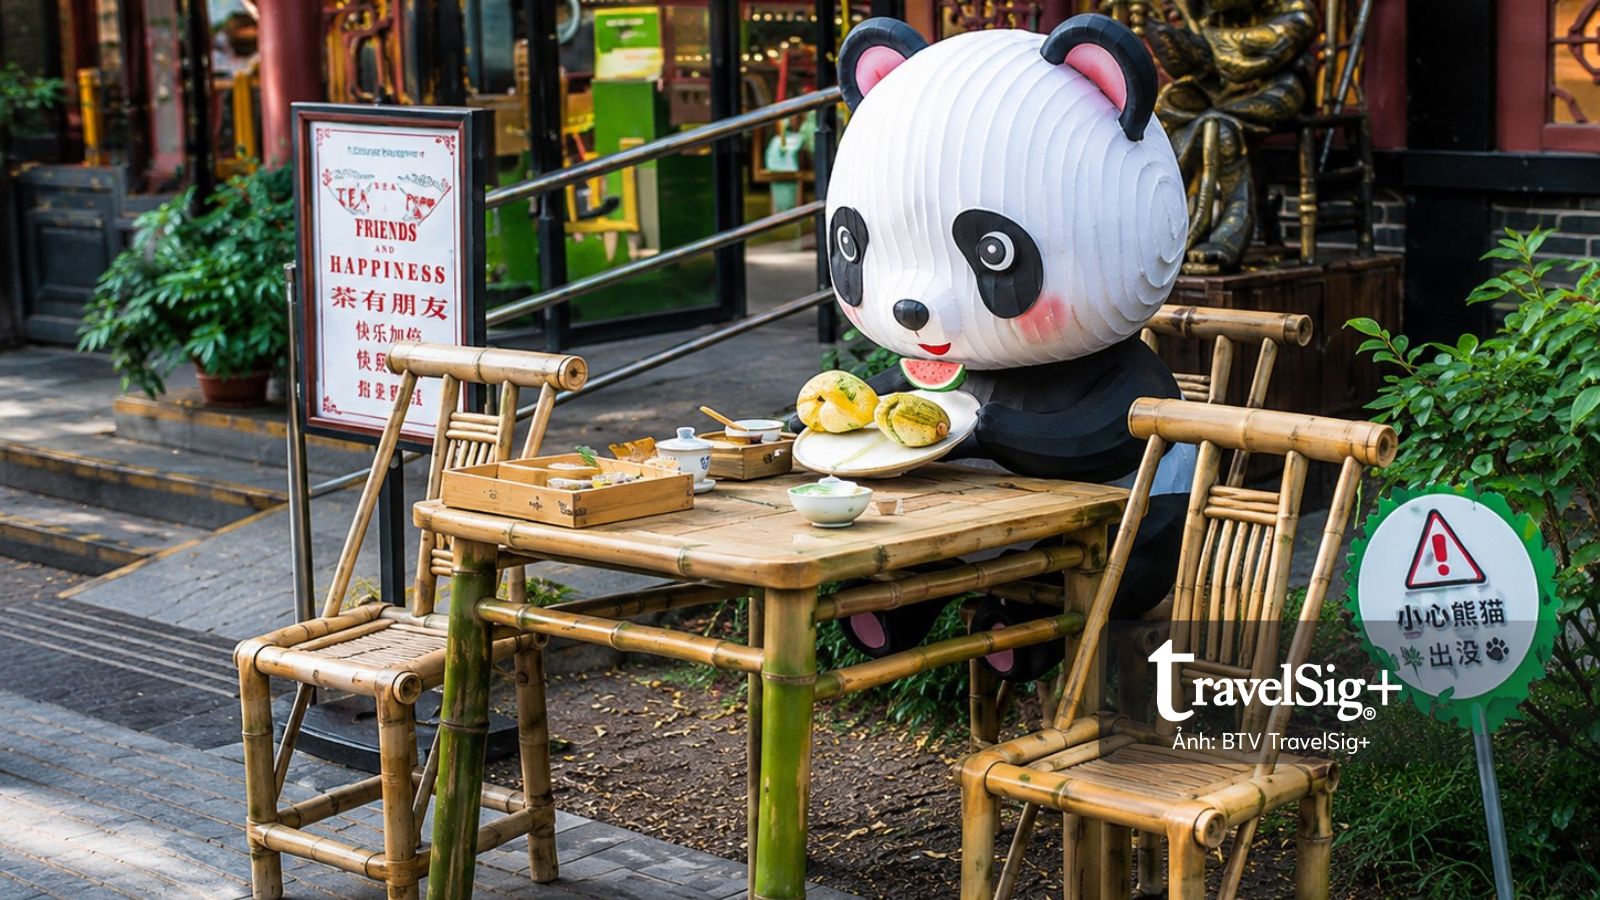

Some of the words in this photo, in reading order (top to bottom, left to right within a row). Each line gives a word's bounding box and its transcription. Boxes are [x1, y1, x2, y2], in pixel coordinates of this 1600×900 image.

[336, 187, 370, 213] TEA
[355, 218, 417, 242] FRIENDS
[374, 245, 395, 254] AND
[330, 255, 446, 284] HAPPINESS
[331, 286, 448, 321] 茶有朋友
[1397, 599, 1505, 631] 小心熊猫
[1429, 640, 1482, 667] 出没
